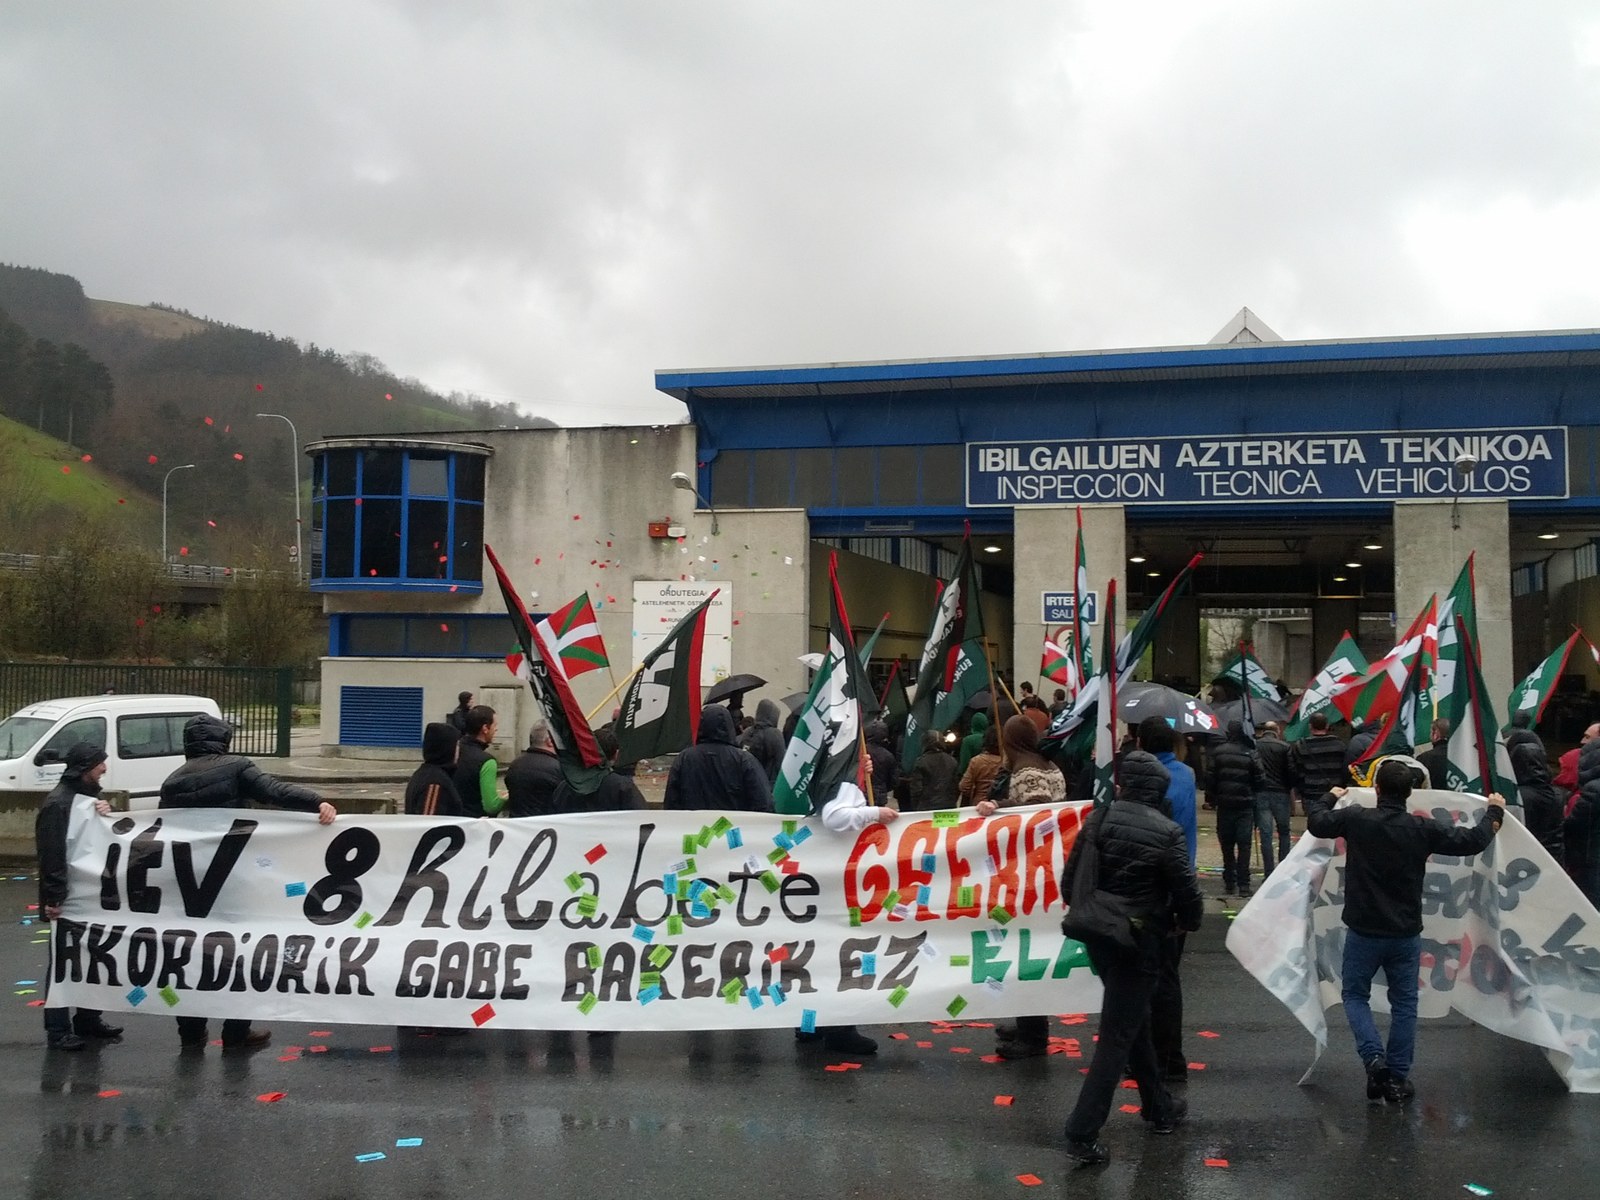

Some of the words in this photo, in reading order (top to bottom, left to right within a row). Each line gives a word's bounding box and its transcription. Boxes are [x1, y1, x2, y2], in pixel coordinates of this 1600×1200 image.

[978, 443, 1161, 472] IBILGAILUEN
[1175, 438, 1367, 468] AZTERKETA
[1380, 434, 1553, 464] TEKNIKOA
[997, 472, 1165, 500] INSPECCION
[1193, 468, 1323, 497] TECNICA
[1355, 465, 1532, 494] VEHICULOS
[659, 589, 705, 597] ORDUTEGIA
[1046, 596, 1094, 607] IRTEEA
[303, 826, 381, 926] 8
[395, 938, 533, 1000] GABE
[837, 930, 928, 992] EZ
